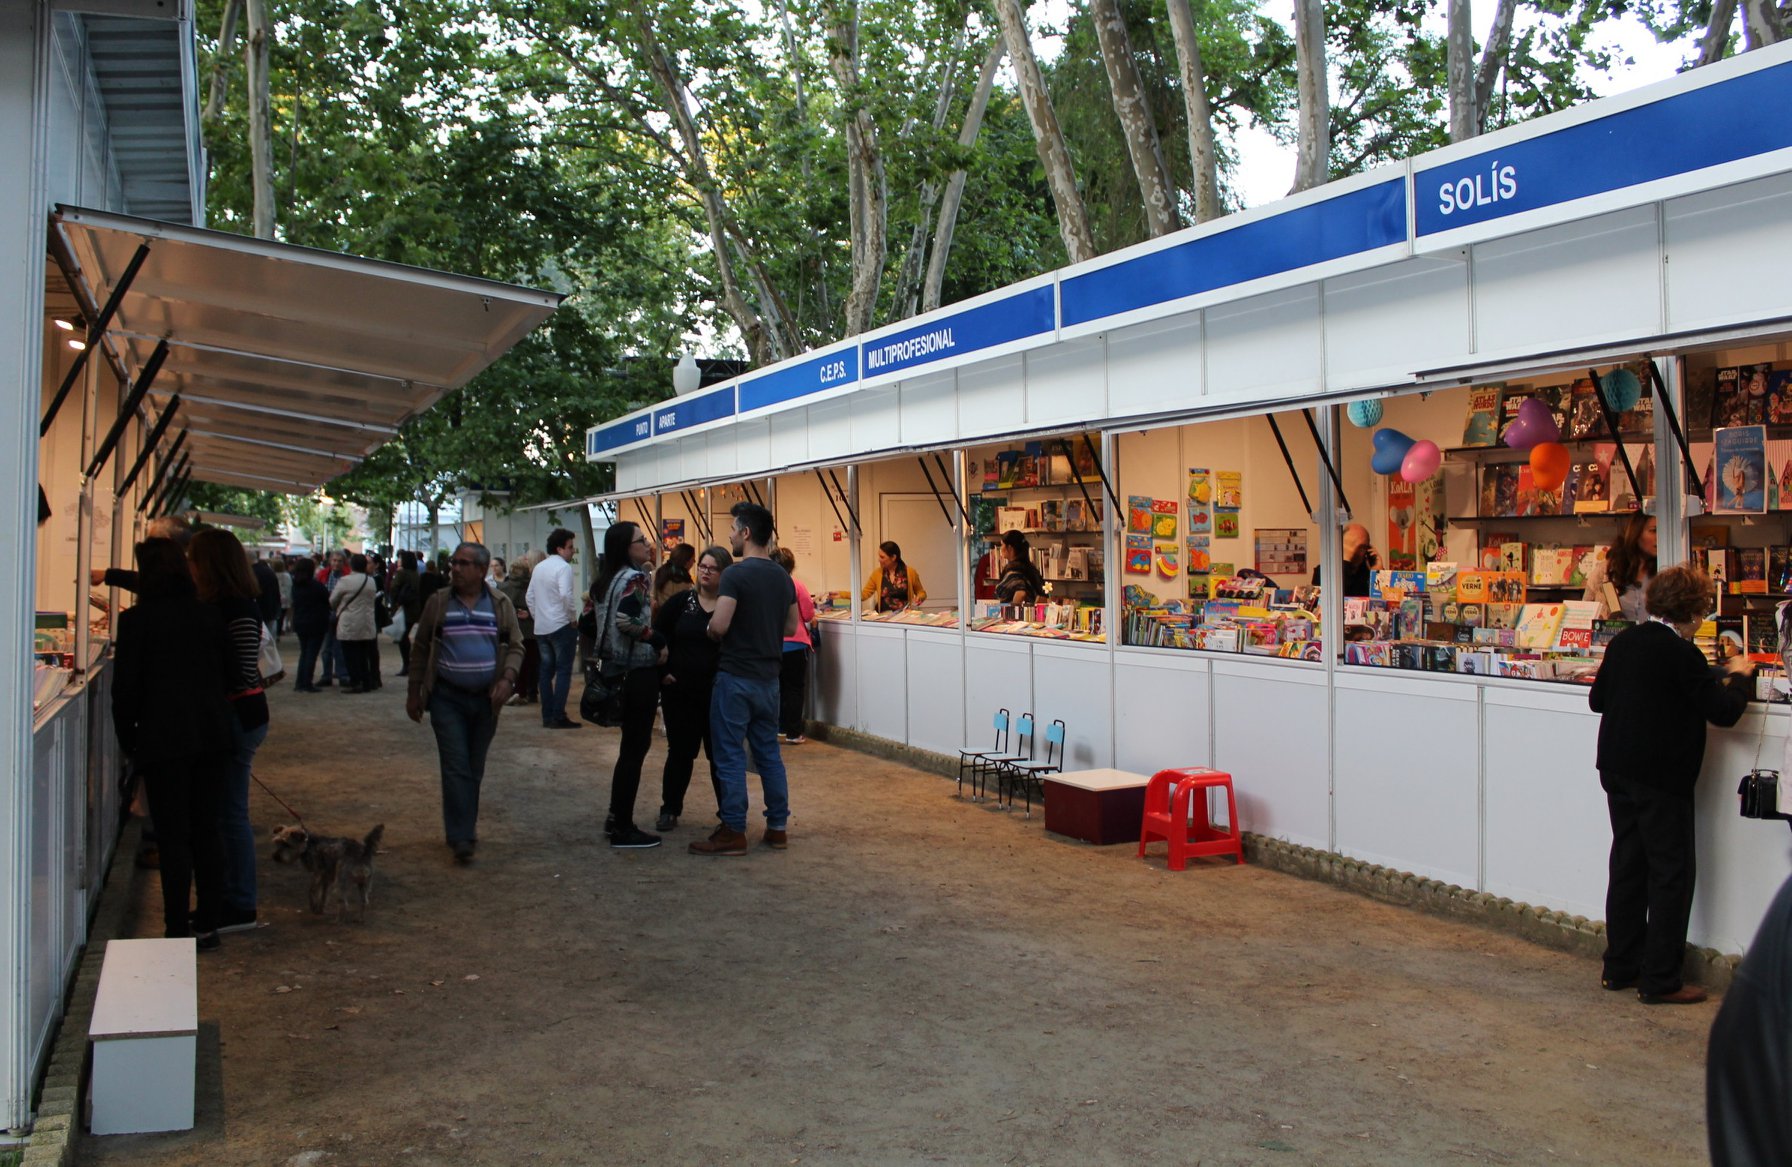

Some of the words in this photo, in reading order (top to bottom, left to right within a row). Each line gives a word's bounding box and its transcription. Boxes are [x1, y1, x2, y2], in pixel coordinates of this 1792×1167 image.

[1439, 160, 1517, 215] SOLÍS
[868, 328, 955, 369] MULTIPROFESIONAL
[820, 360, 847, 383] C.E.P.S.
[636, 421, 648, 437] PUNTO
[659, 412, 676, 429] APARTE
[1562, 630, 1590, 642] BOWIE
